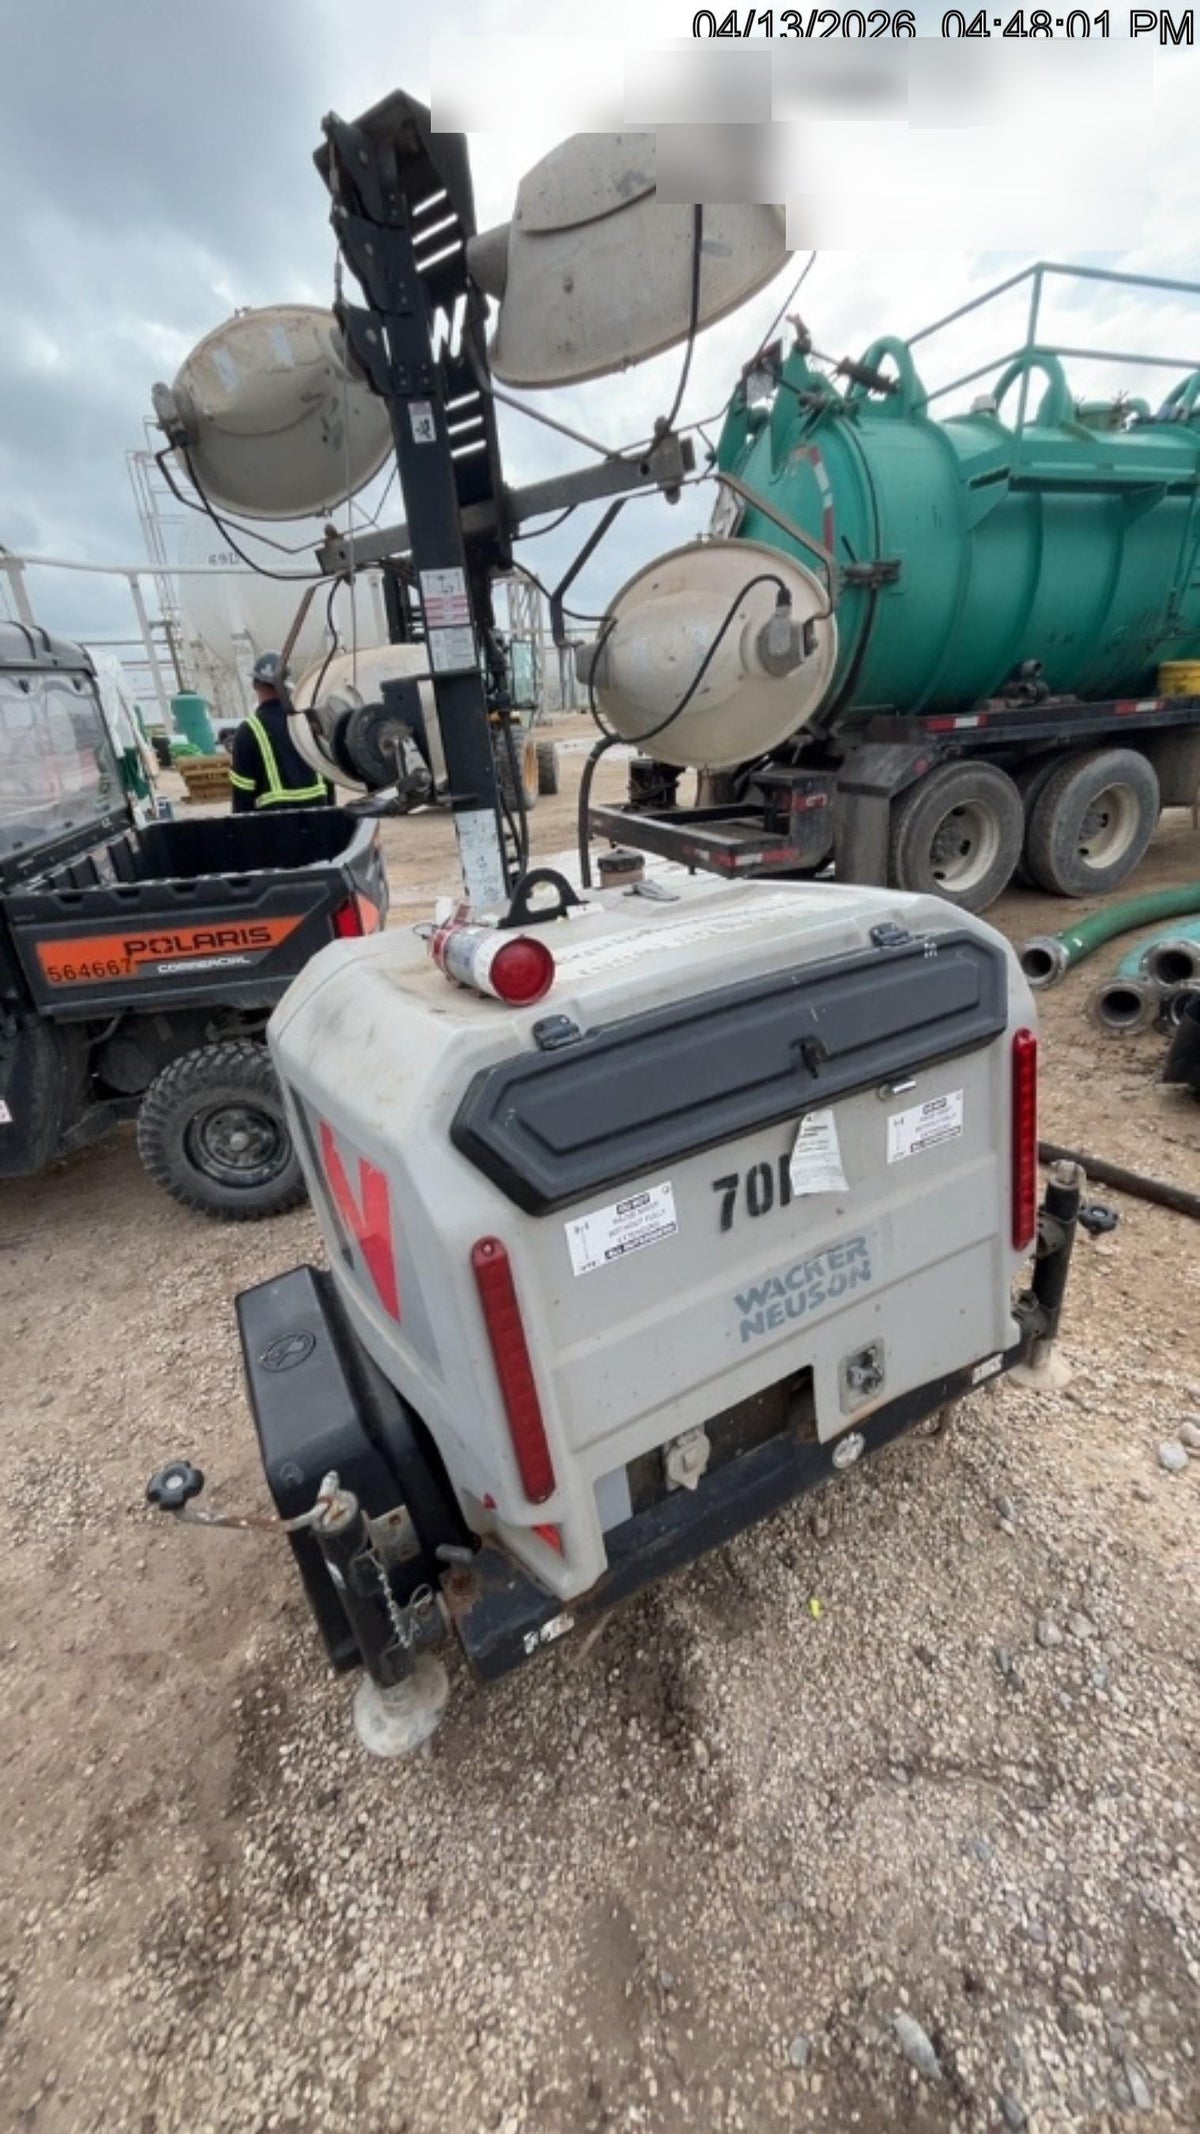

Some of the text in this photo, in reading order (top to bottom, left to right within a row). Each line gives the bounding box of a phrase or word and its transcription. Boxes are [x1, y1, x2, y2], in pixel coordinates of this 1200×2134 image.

[123, 926, 272, 956] POLARIS
[47, 957, 135, 983] 564667
[734, 1237, 869, 1315] WACKER
[739, 1259, 872, 1344] NEUSON
